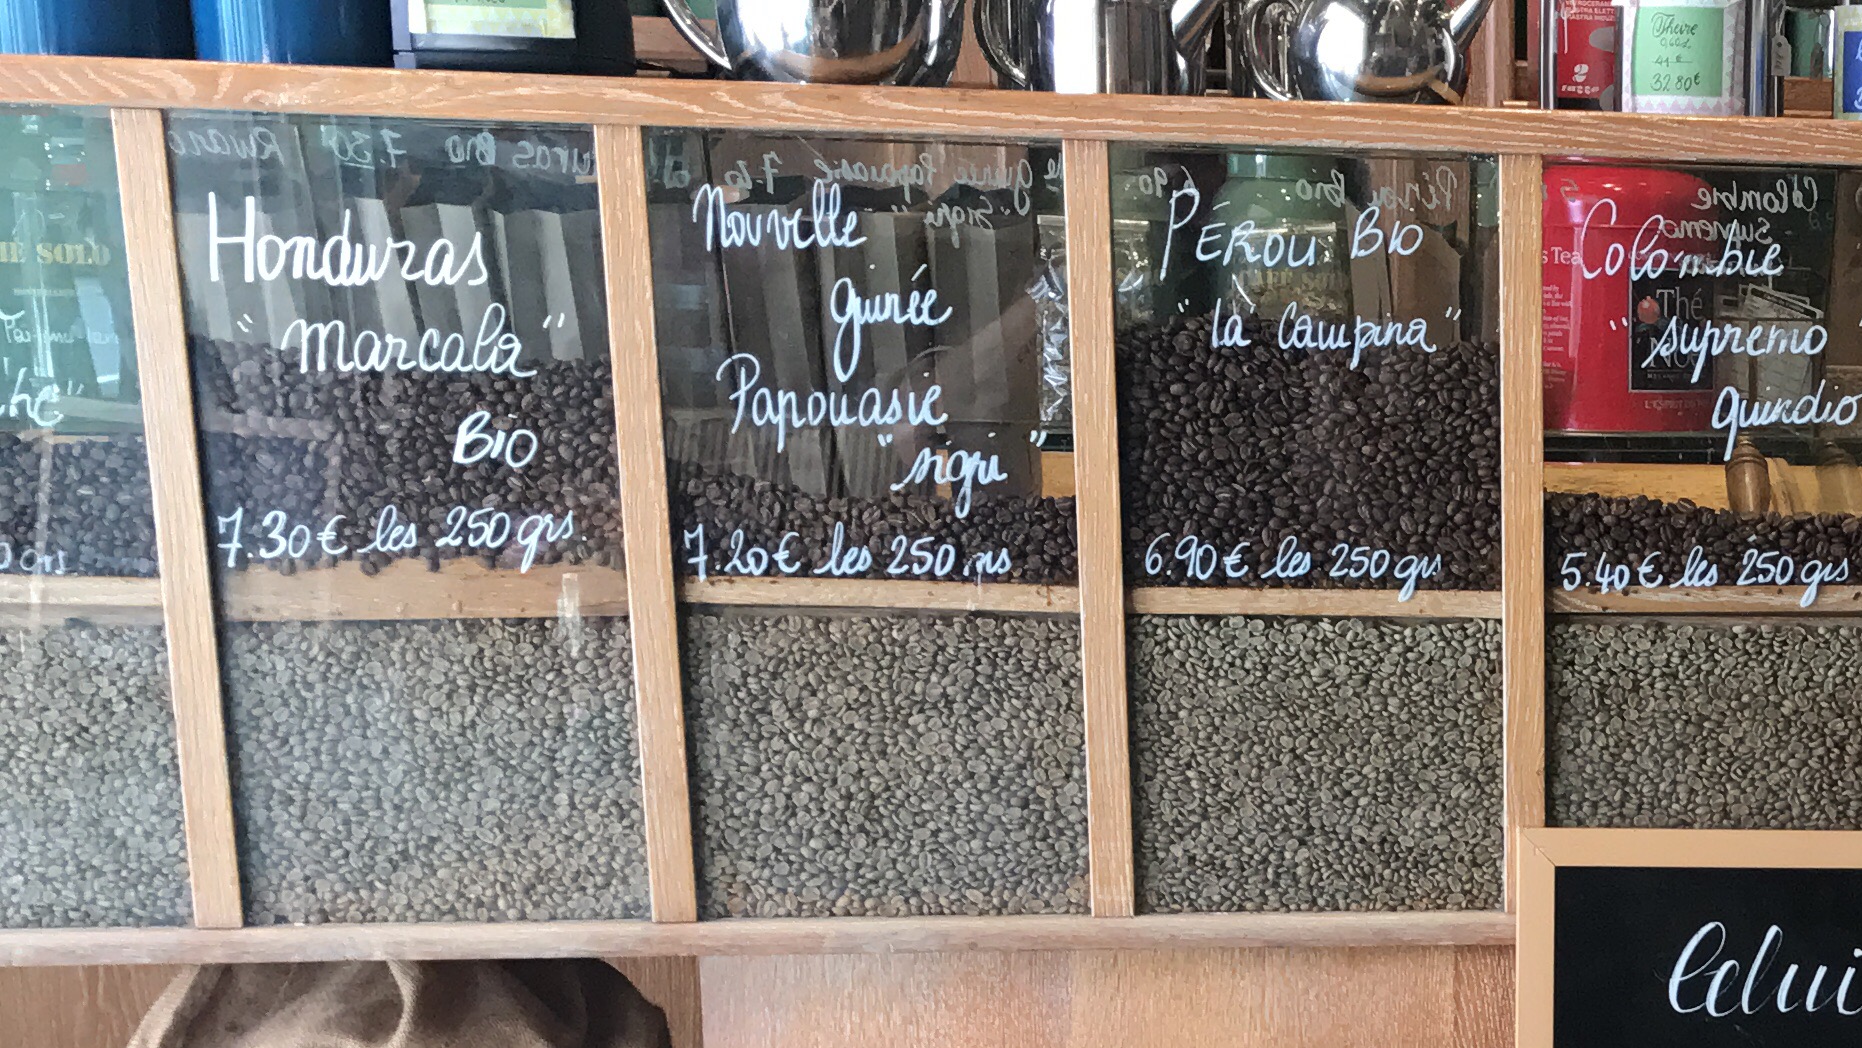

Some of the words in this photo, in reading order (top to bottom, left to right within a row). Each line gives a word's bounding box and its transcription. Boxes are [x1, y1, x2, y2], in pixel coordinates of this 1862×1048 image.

[208, 191, 488, 286] Honduras
[693, 182, 867, 252] Nouvelle
[1581, 198, 1784, 280] Colombie
[716, 352, 949, 453] Papouasie
[217, 509, 348, 568] 7.30€
[360, 509, 417, 553] les
[435, 506, 508, 549] 250
[813, 523, 872, 577] les
[885, 535, 955, 576] 250
[1145, 533, 1250, 581] 6.90€
[1261, 536, 1312, 579] les
[1329, 541, 1390, 579] 250
[1561, 552, 1664, 594] 5.40€
[1671, 546, 1719, 588] les
[1737, 549, 1793, 586] 250
[1800, 557, 1849, 607] grs
